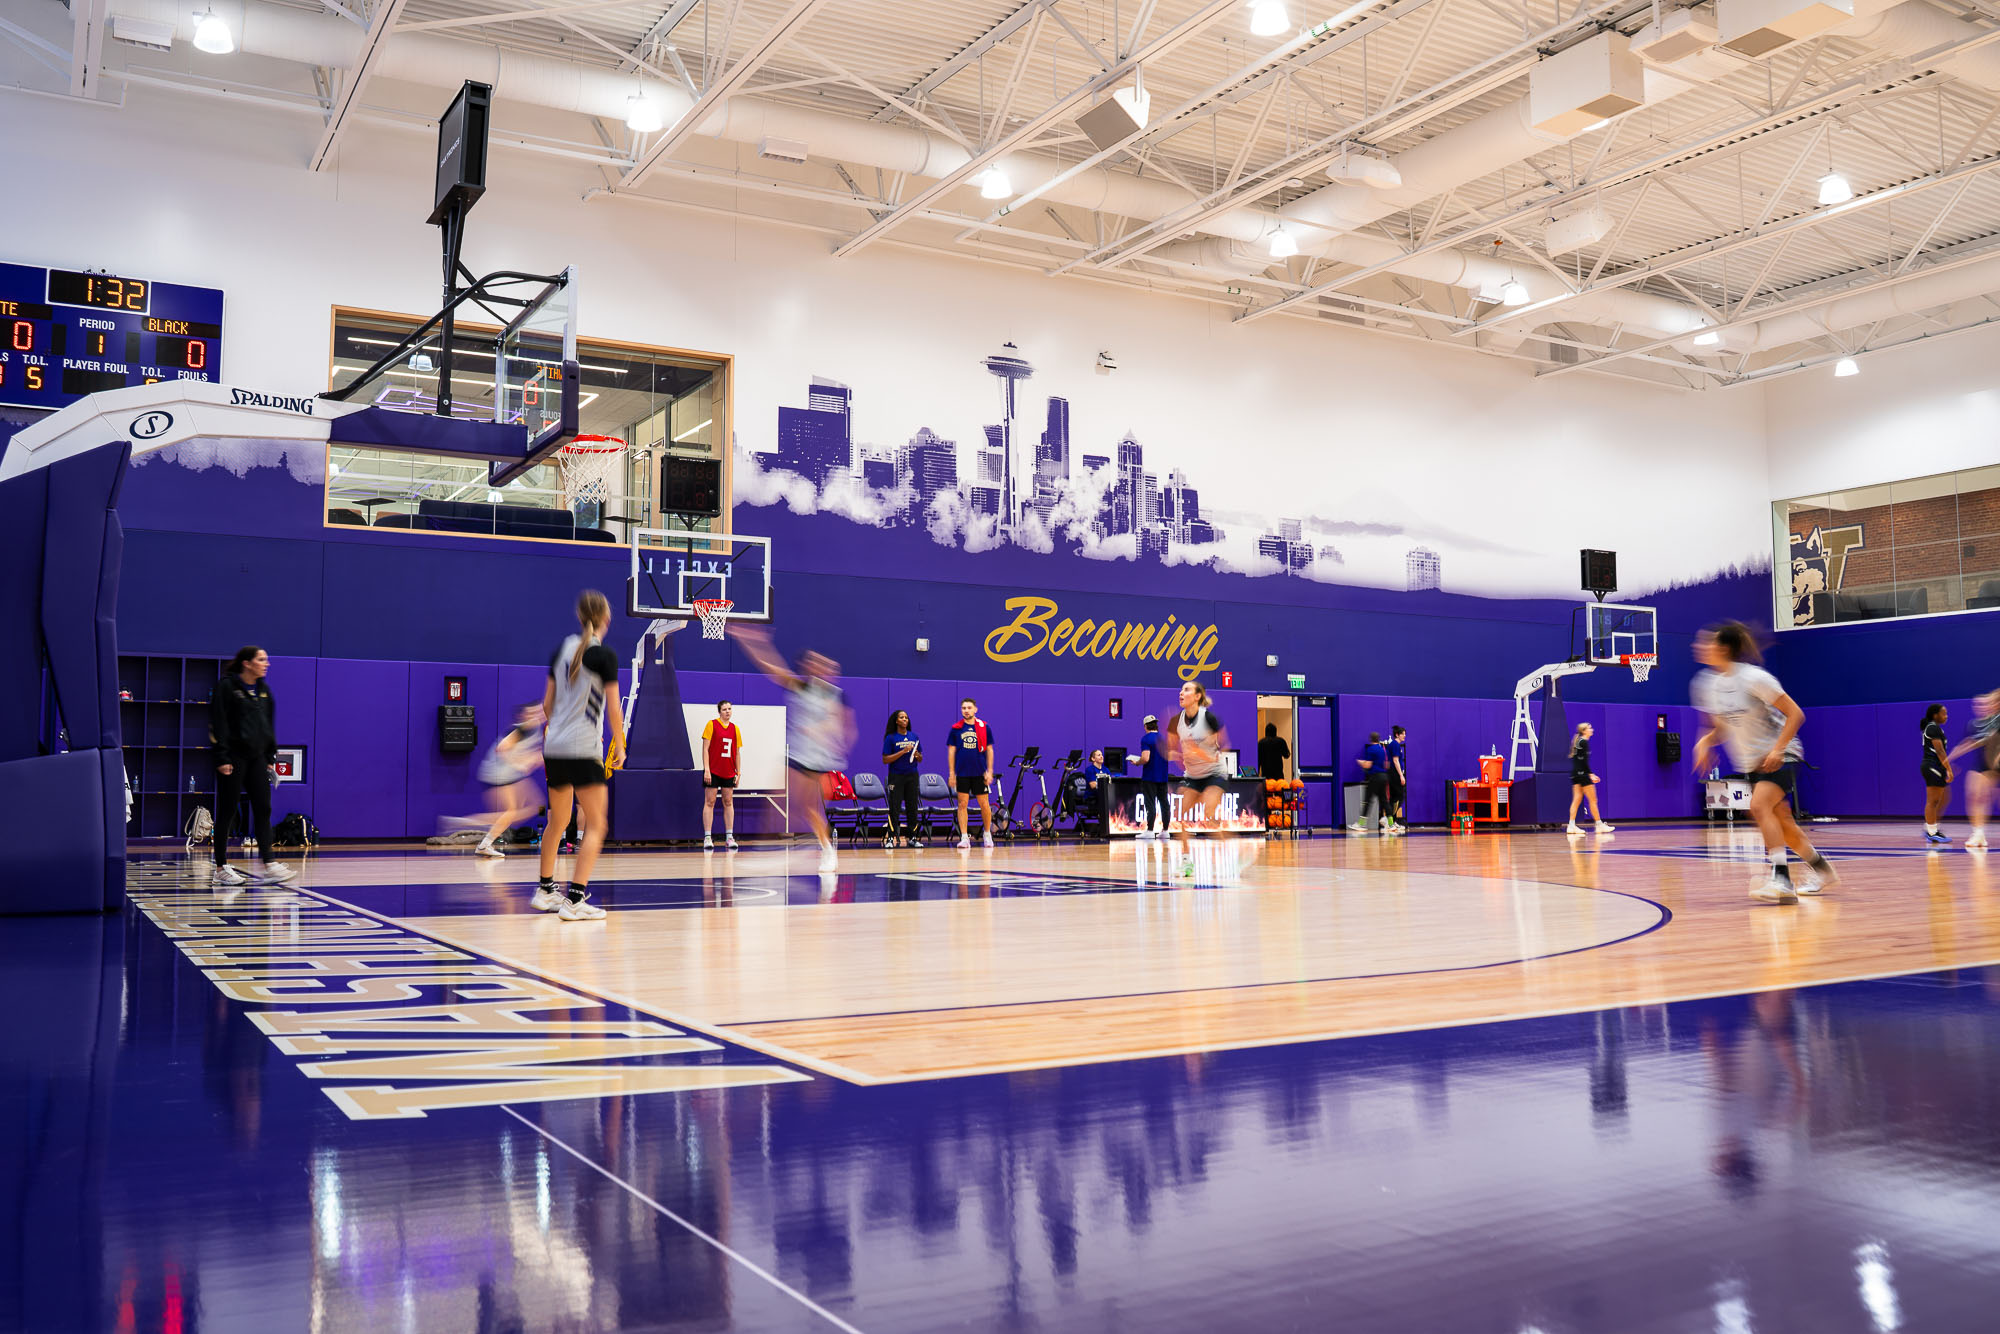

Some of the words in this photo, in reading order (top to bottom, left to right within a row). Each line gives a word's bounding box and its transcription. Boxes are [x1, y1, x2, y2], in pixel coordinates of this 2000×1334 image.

[86, 277, 145, 310] 1:32
[79, 317, 116, 331] PERIOD
[148, 317, 190, 336] BLACK
[13, 320, 33, 351] 0
[98, 334, 105, 355] 1
[22, 353, 49, 367] T.O.L.
[187, 340, 206, 369] 0
[62, 358, 101, 372] PLAYER
[104, 362, 130, 375] FOUL
[140, 366, 166, 379] T.O.L.
[177, 370, 208, 382] FOULS
[27, 366, 42, 389] 5
[230, 387, 314, 416] SPALDING
[983, 596, 1221, 682] Becoming
[721, 737, 732, 758] 3
[126, 890, 816, 1121] WASHINGTON
